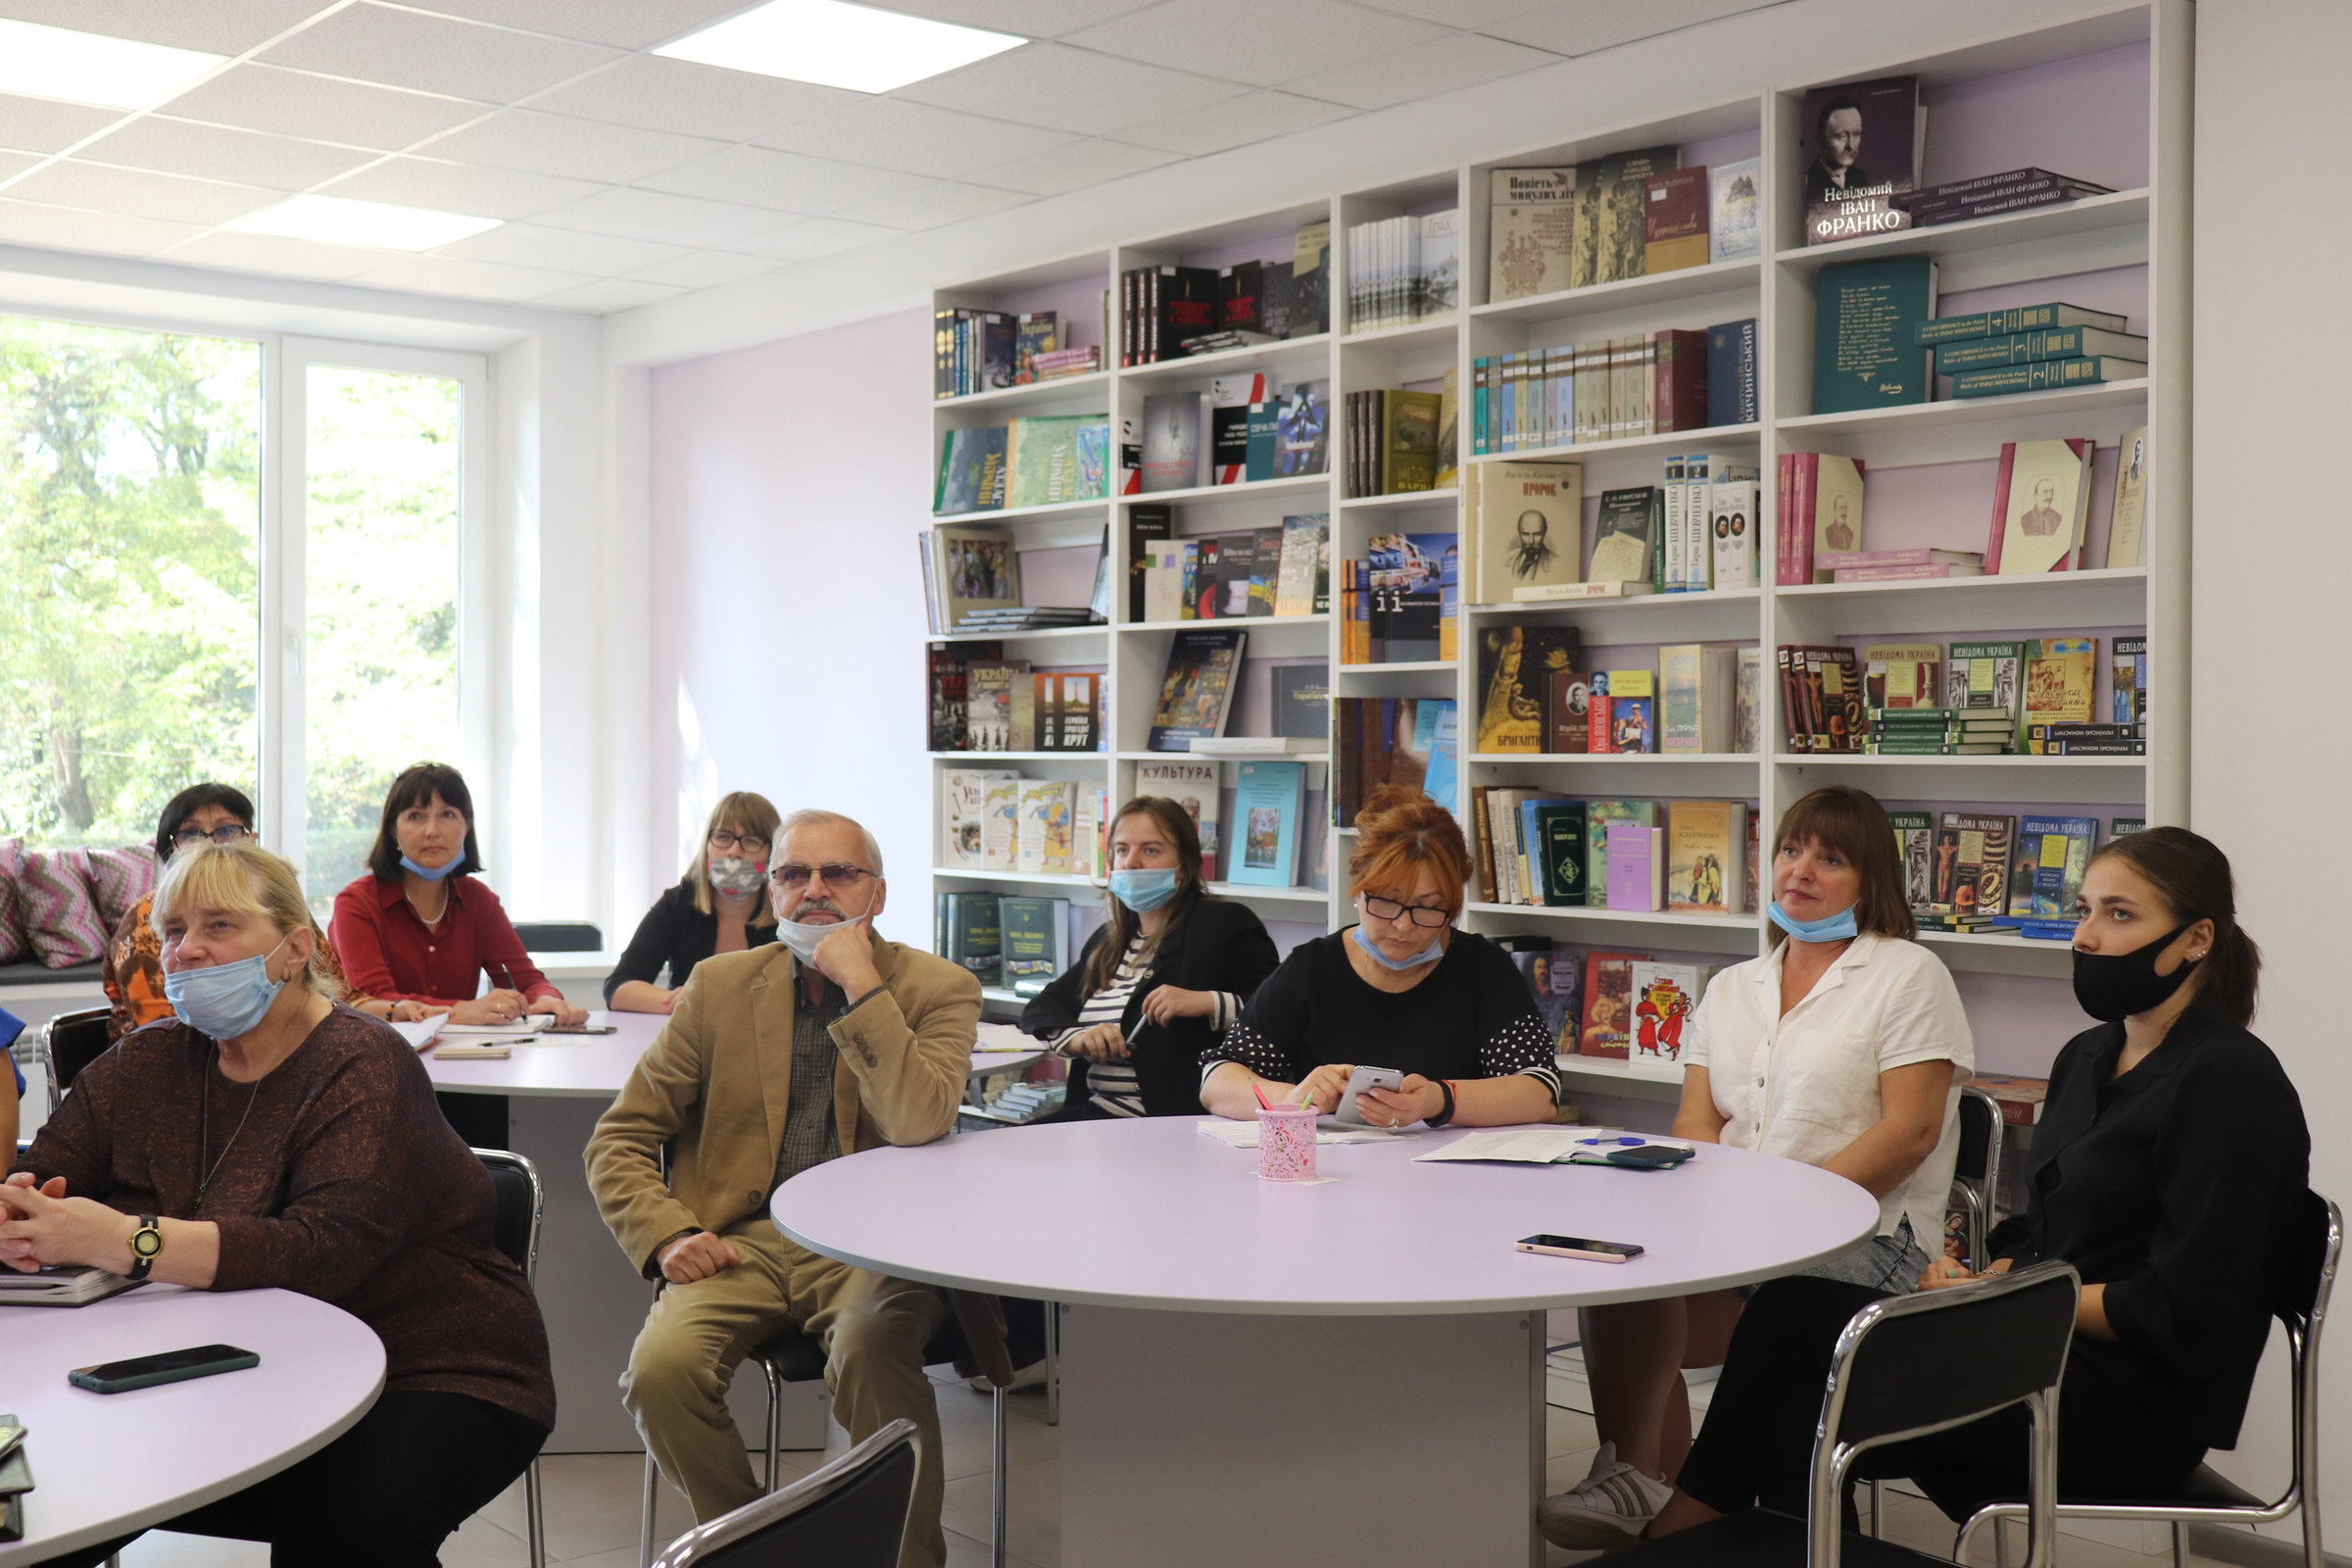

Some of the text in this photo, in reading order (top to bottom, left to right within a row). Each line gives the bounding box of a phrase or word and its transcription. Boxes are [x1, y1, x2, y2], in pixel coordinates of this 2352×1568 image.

[1510, 176, 1552, 189] Повість
[1974, 178, 1992, 189] ІВАН
[1992, 172, 2026, 185] ФРАНКО
[1824, 180, 1892, 202] Невідомий
[1996, 187, 2015, 197] ІВАН
[2016, 179, 2049, 193] ФРАНКО
[2008, 197, 2028, 208] ІВАН
[2027, 190, 2061, 204] ФРАНКО
[1840, 199, 1876, 216] ІВАН
[1817, 211, 1900, 236] ФРАНКО
[1742, 324, 1754, 422] КИЧИНСЬКИЙ
[2033, 370, 2044, 379] 2
[1671, 467, 1676, 478] 1
[1693, 466, 1701, 477] 2
[1523, 482, 1556, 497] ПРОРОК
[1669, 486, 1679, 543] ШЕВЧЕНКО
[1691, 486, 1701, 543] ШЕВЧЕНКО
[1870, 649, 1936, 661] НЕВІДОМА УКРАЇНА
[1953, 645, 2013, 658] НЕВІДОМА УКРАЇНА
[1143, 766, 1212, 779] КУЛЬТУРА
[1894, 817, 1926, 828] УКРАЇНА
[1978, 820, 2004, 831] УКРАЇНА
[2026, 822, 2088, 834] НЕВІДОМА УКРАЇНА
